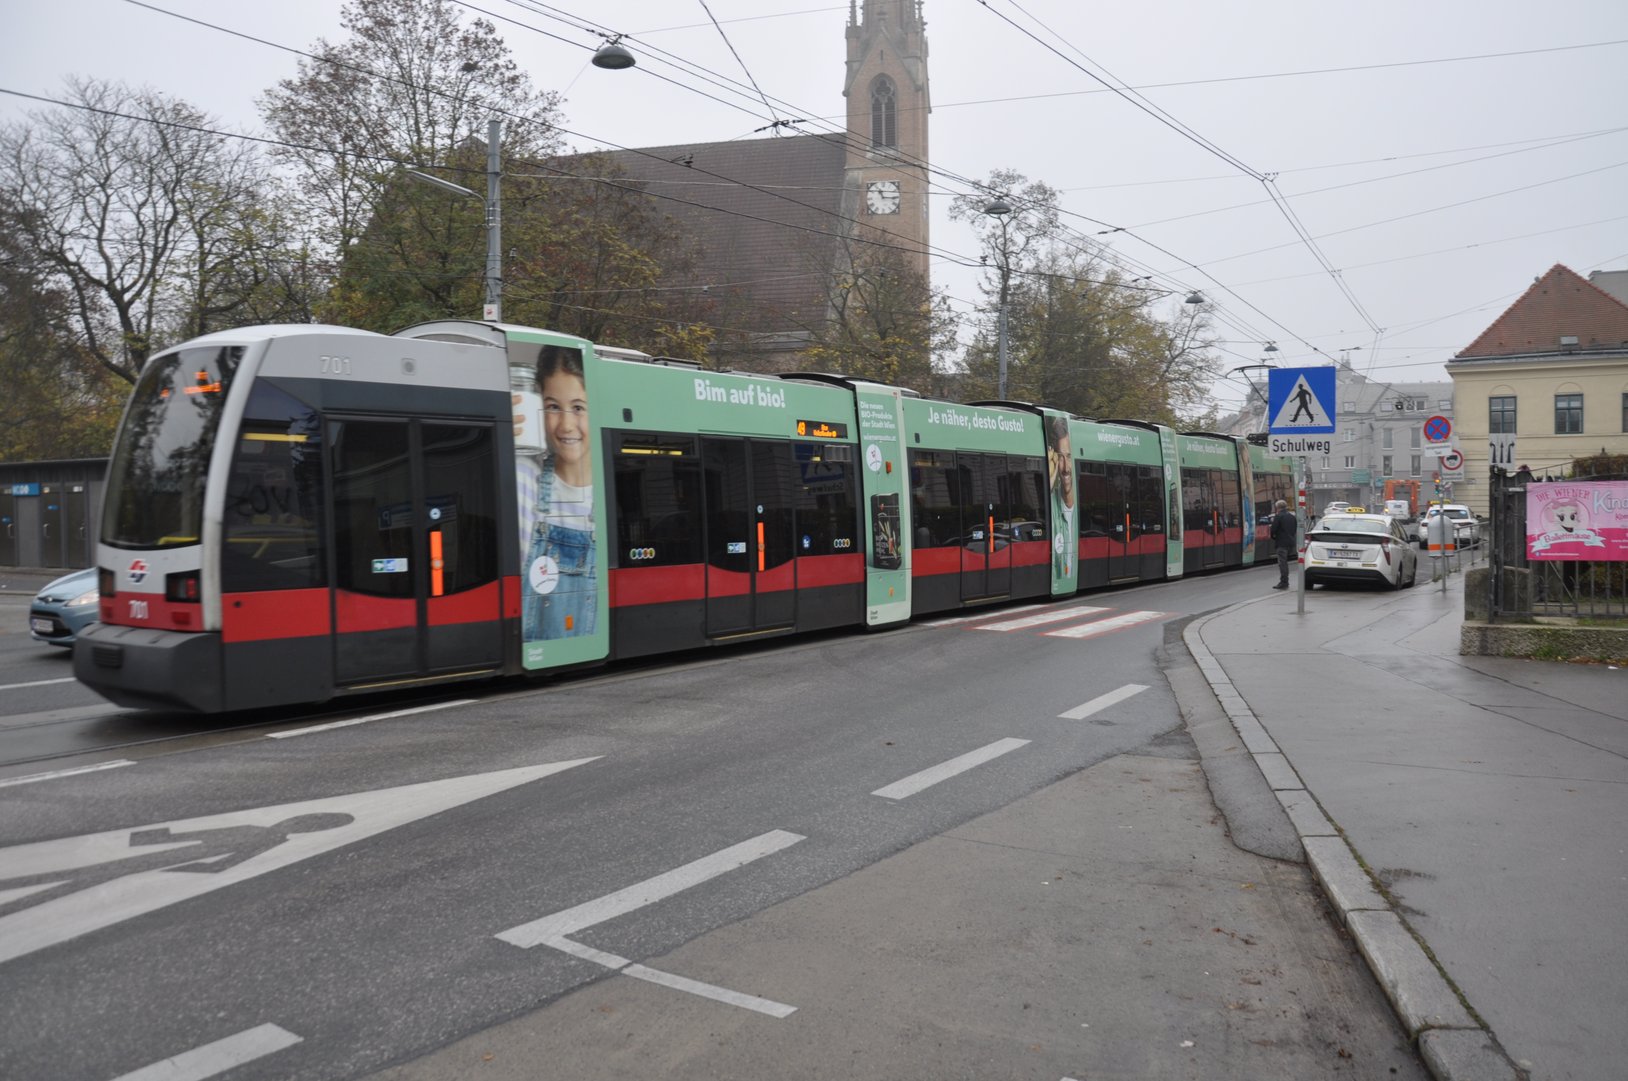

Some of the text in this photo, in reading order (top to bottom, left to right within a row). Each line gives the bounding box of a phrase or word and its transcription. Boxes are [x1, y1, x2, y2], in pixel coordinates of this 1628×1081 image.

[320, 355, 351, 375] 701
[694, 379, 786, 408] Bim auf bio!
[797, 421, 806, 436] 49
[928, 407, 1025, 433] Je näher, desto Gusto!
[1272, 438, 1330, 455] Schulweg
[1536, 488, 1591, 503] DIE WIENER
[128, 600, 149, 619] 701
